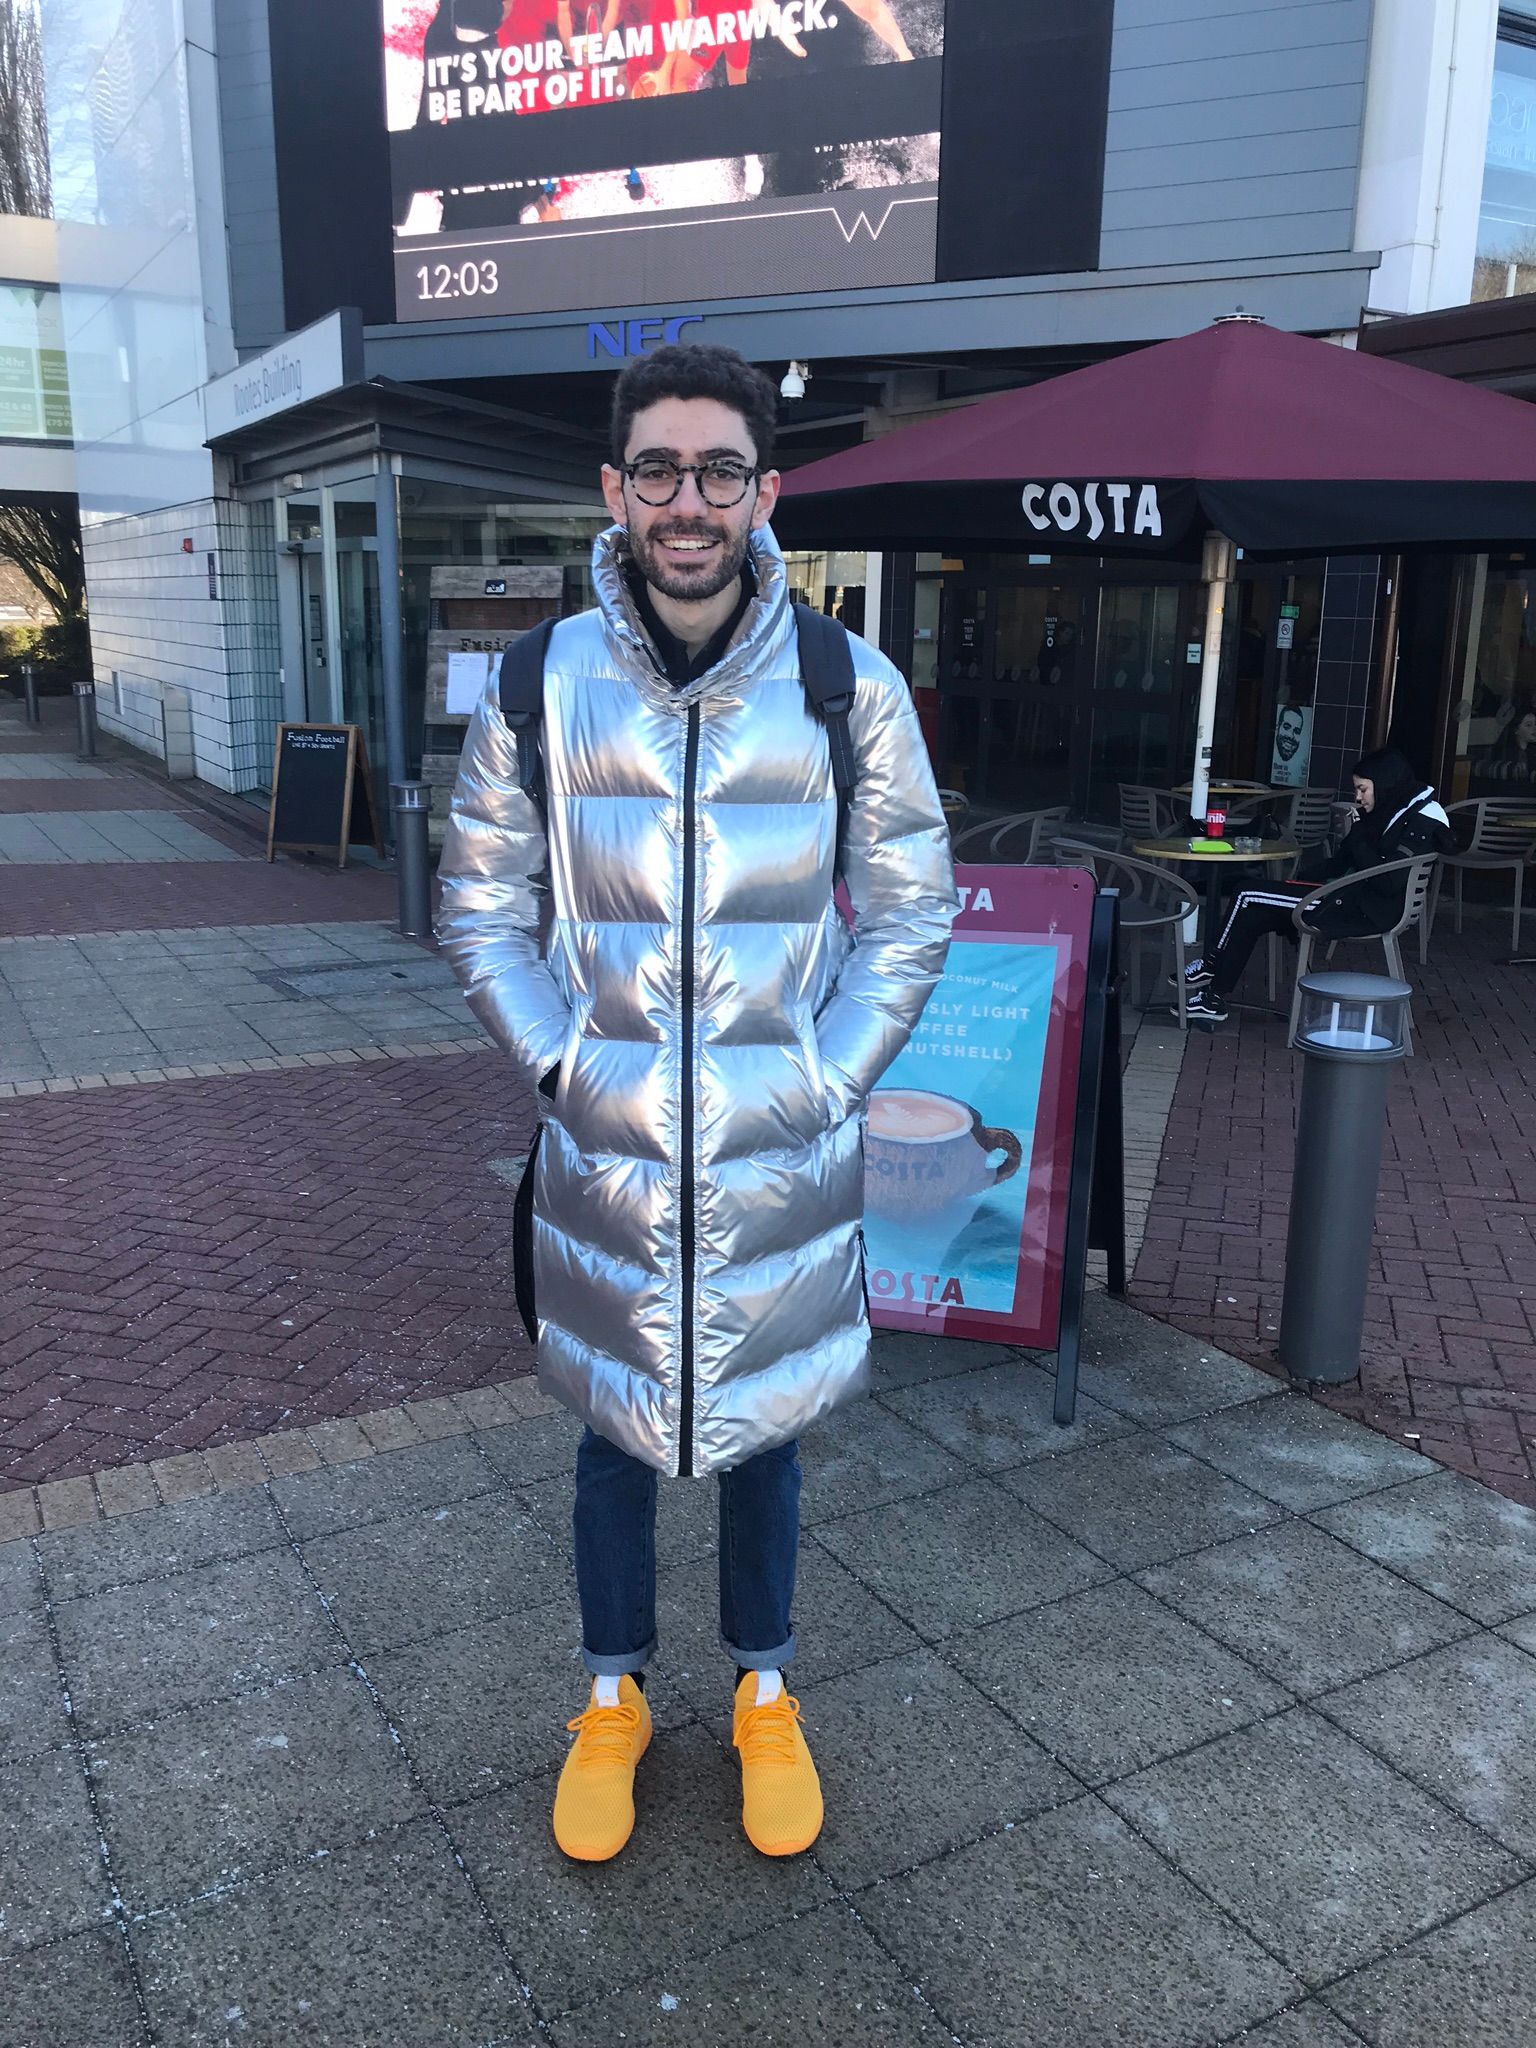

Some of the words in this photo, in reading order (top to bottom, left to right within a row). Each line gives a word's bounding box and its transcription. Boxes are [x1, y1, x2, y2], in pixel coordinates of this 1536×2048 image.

[427, 52, 478, 88] IT'S
[483, 39, 563, 75] YOUR
[570, 24, 655, 69] TEAM
[661, 1, 839, 53] WARWICK.
[428, 88, 464, 122] BE
[467, 78, 539, 116] PART
[544, 72, 584, 106] OF
[590, 67, 625, 100] IT.
[416, 260, 499, 300] 12:03
[588, 315, 704, 358] NEC
[263, 353, 302, 403] Building
[1022, 482, 1162, 541] COSTA
[957, 887, 995, 912] TA
[942, 975, 988, 986] OCONUT
[991, 981, 1019, 993] MILK
[911, 1022, 968, 1037] FFEE
[922, 1002, 963, 1017] SLY
[972, 1005, 1031, 1021] LIGHT
[868, 1269, 965, 1306] OSTA
